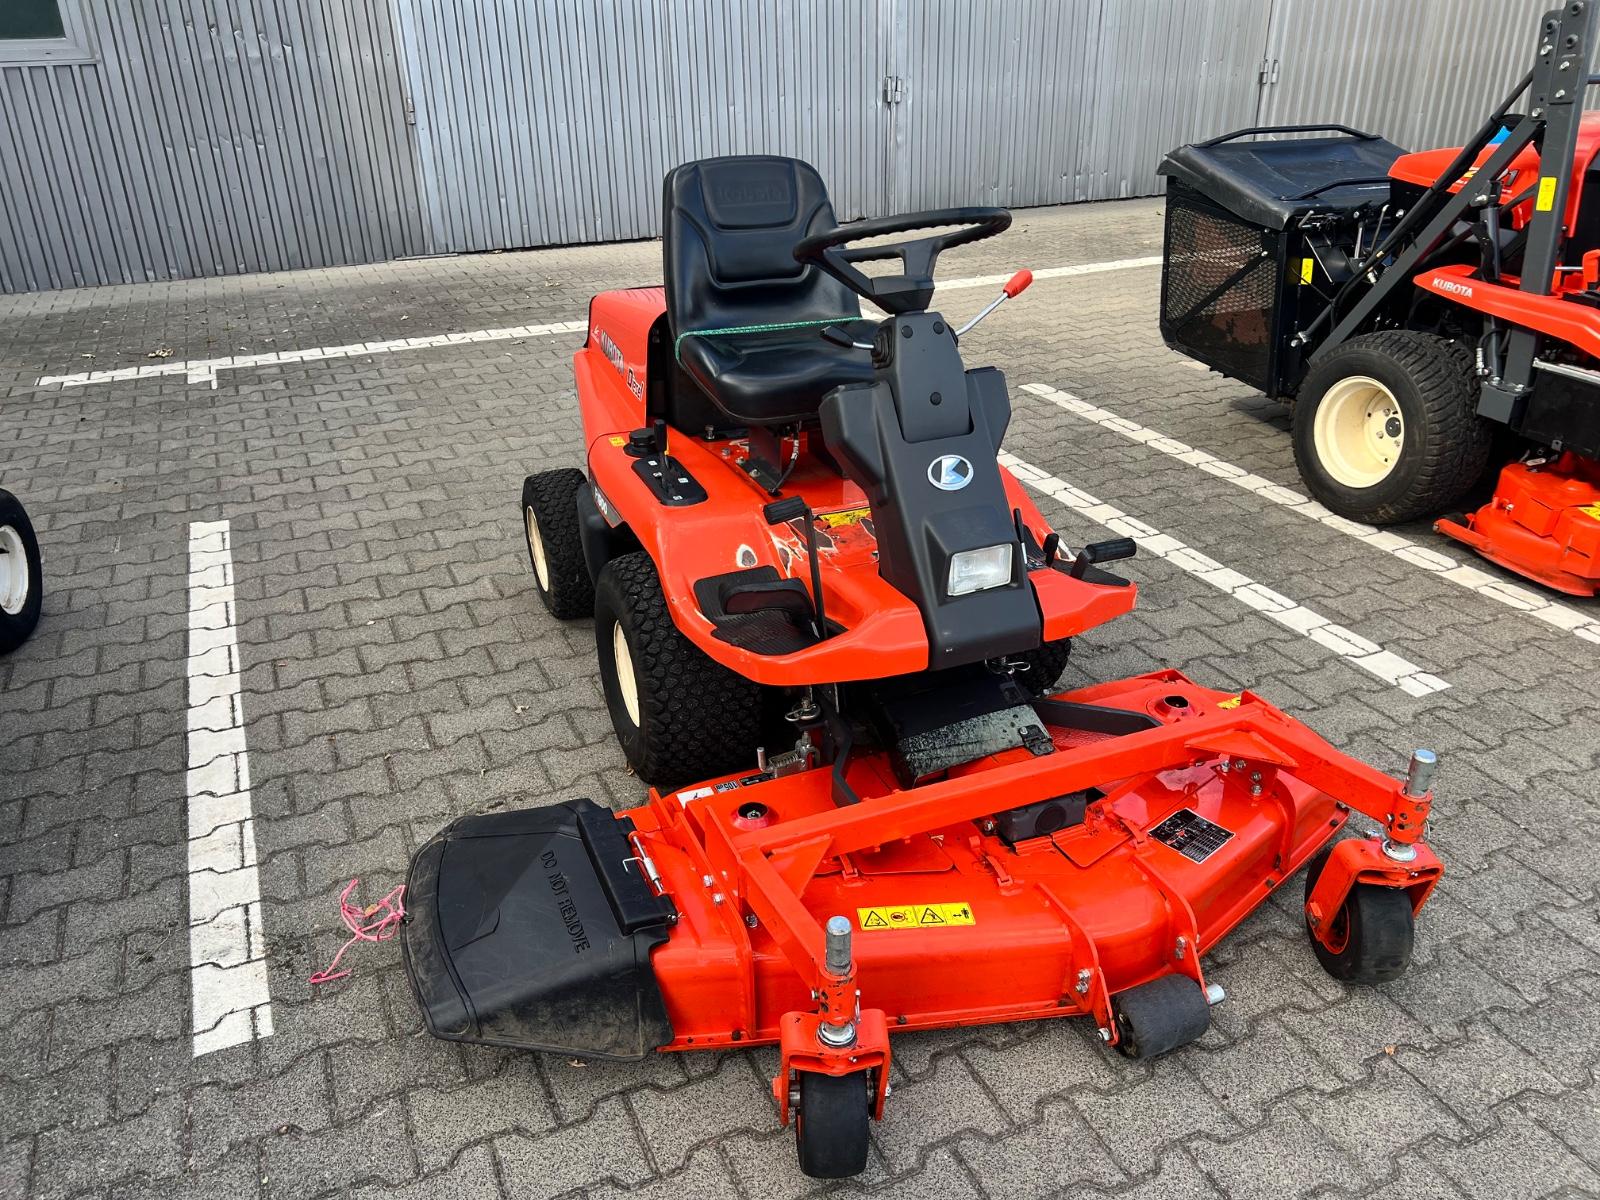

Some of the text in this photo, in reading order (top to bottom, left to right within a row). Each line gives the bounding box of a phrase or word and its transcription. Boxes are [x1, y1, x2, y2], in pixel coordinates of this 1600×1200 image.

[1432, 277, 1473, 297] KUBOTA
[600, 328, 625, 376] KUBOTA
[540, 849, 591, 953] DO NOT REMOVE
